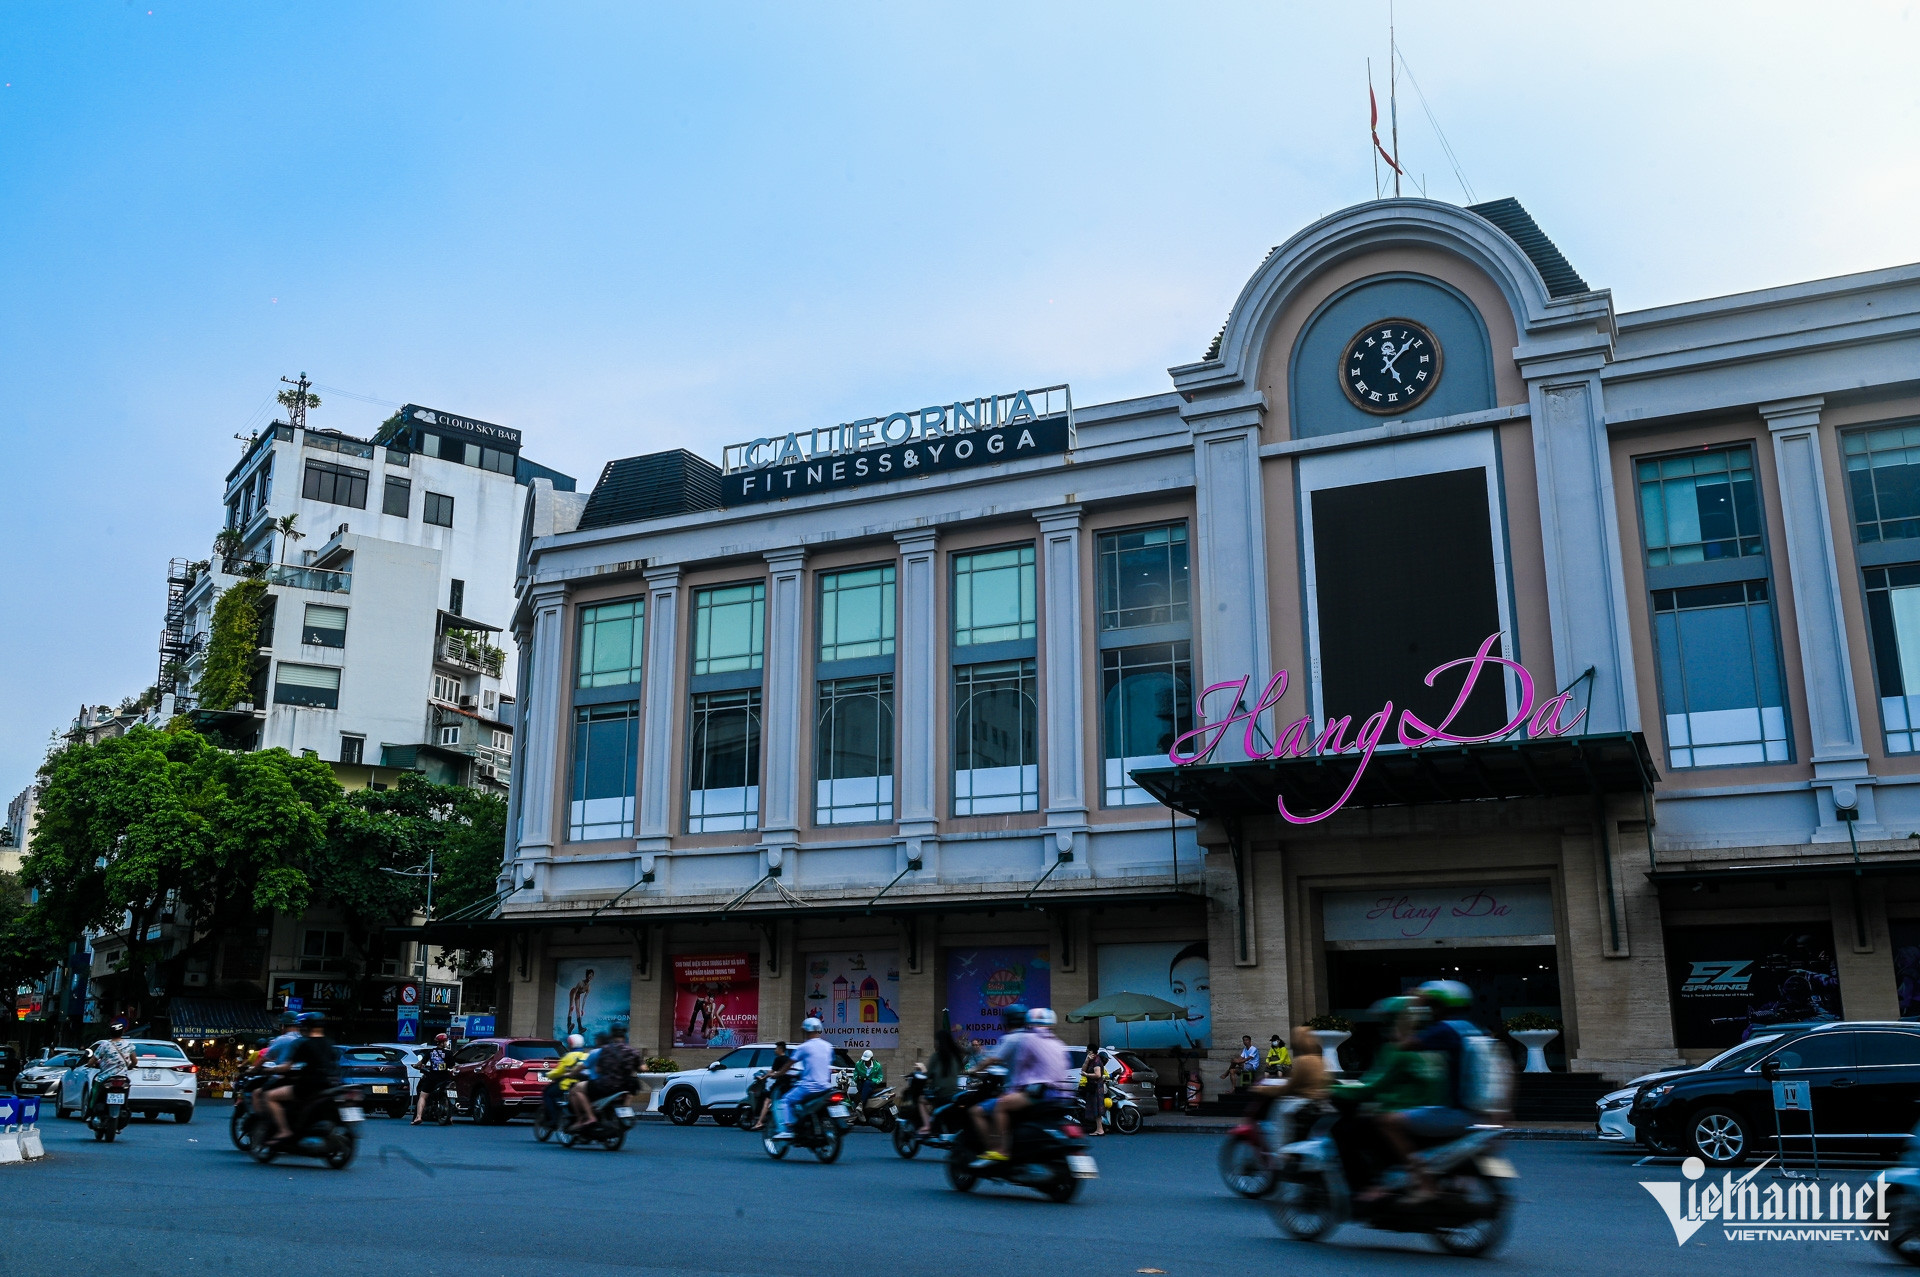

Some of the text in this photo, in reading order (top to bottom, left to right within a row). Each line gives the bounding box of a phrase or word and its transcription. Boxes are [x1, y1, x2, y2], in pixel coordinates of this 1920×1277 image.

[438, 415, 517, 442] CLOUD SKY BAR
[744, 389, 1040, 470] CALIFORNIA
[1168, 630, 1587, 824] Hang Da
[1366, 889, 1512, 937] Hàng Da
[1681, 983, 1749, 992] GAMING
[857, 1025, 869, 1034] TRẺ
